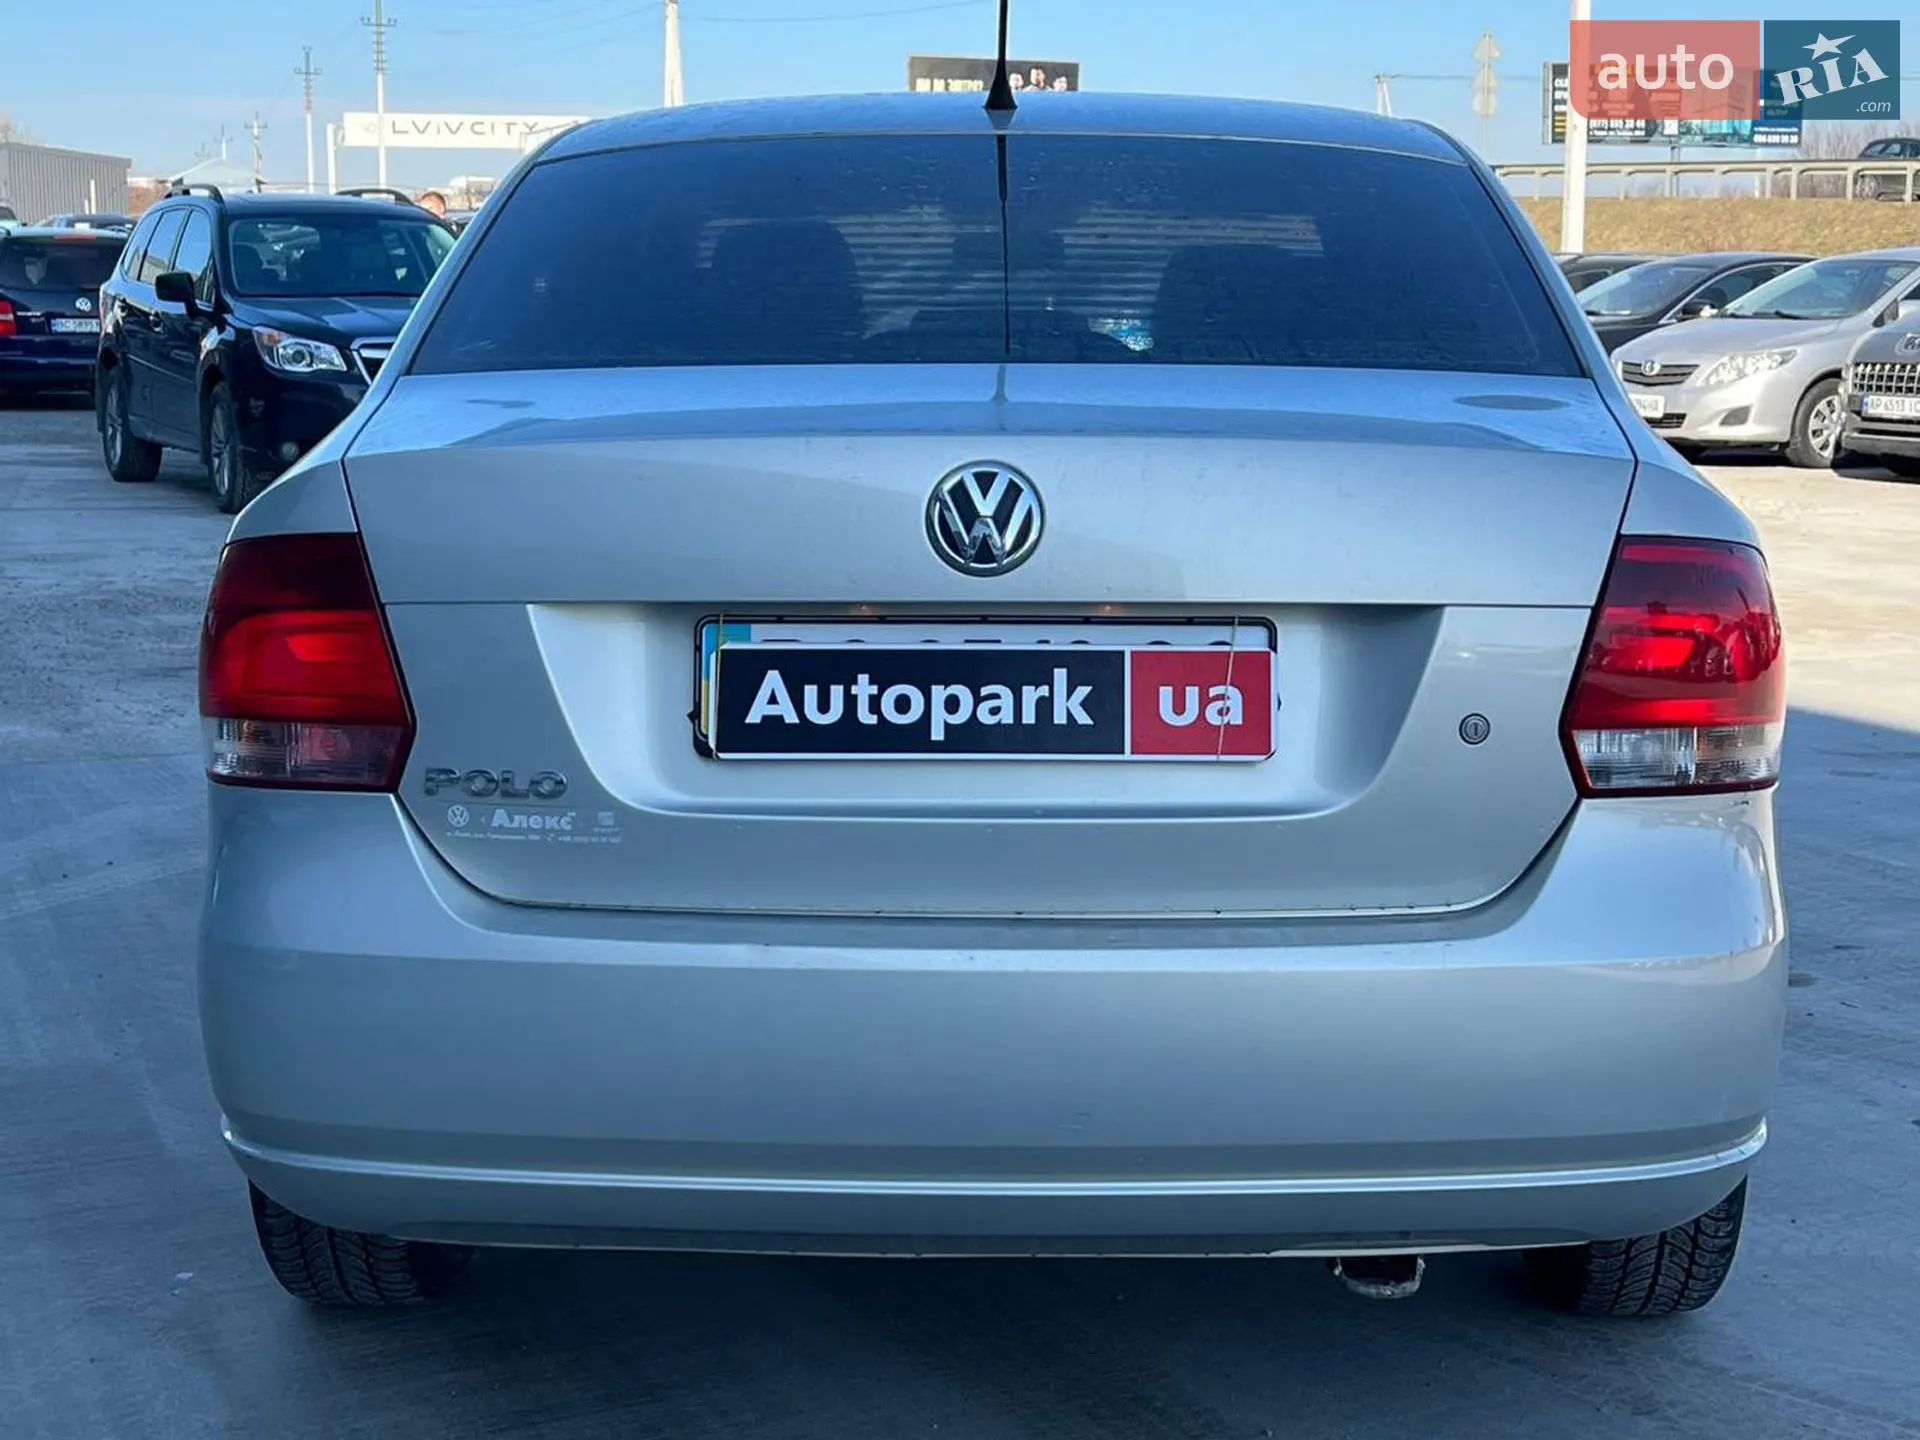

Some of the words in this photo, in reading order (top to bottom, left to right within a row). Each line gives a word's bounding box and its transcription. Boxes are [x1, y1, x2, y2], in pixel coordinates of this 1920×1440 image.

[744, 667, 1095, 741] Autopark
[1158, 684, 1244, 727] ua
[423, 767, 569, 800] POLO
